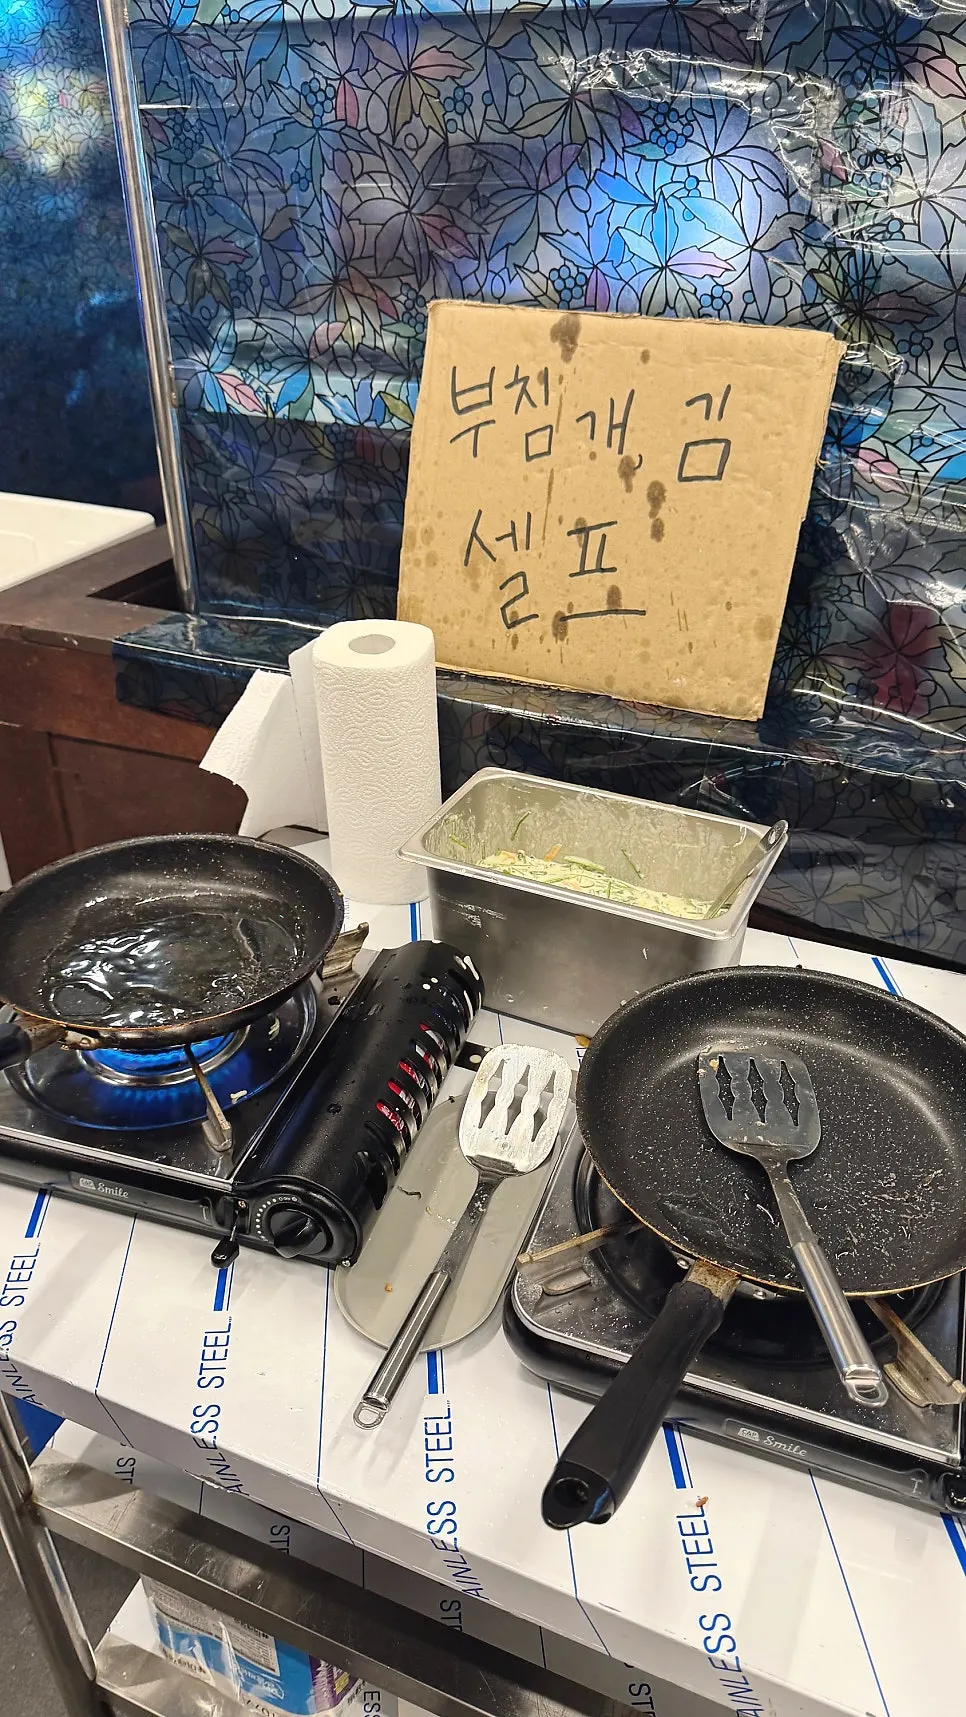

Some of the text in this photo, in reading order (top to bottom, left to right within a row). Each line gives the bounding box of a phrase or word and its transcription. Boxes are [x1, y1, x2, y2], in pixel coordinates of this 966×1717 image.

[677, 384, 732, 483] 김
[463, 510, 647, 630] 셀프
[97, 1181, 130, 1199] Smile
[0, 1247, 40, 1307] STEEL
[196, 1322, 232, 1389] STEEL
[423, 1407, 456, 1483] STEEL
[762, 1434, 808, 1458] Smile
[675, 1505, 723, 1592] STEEL
